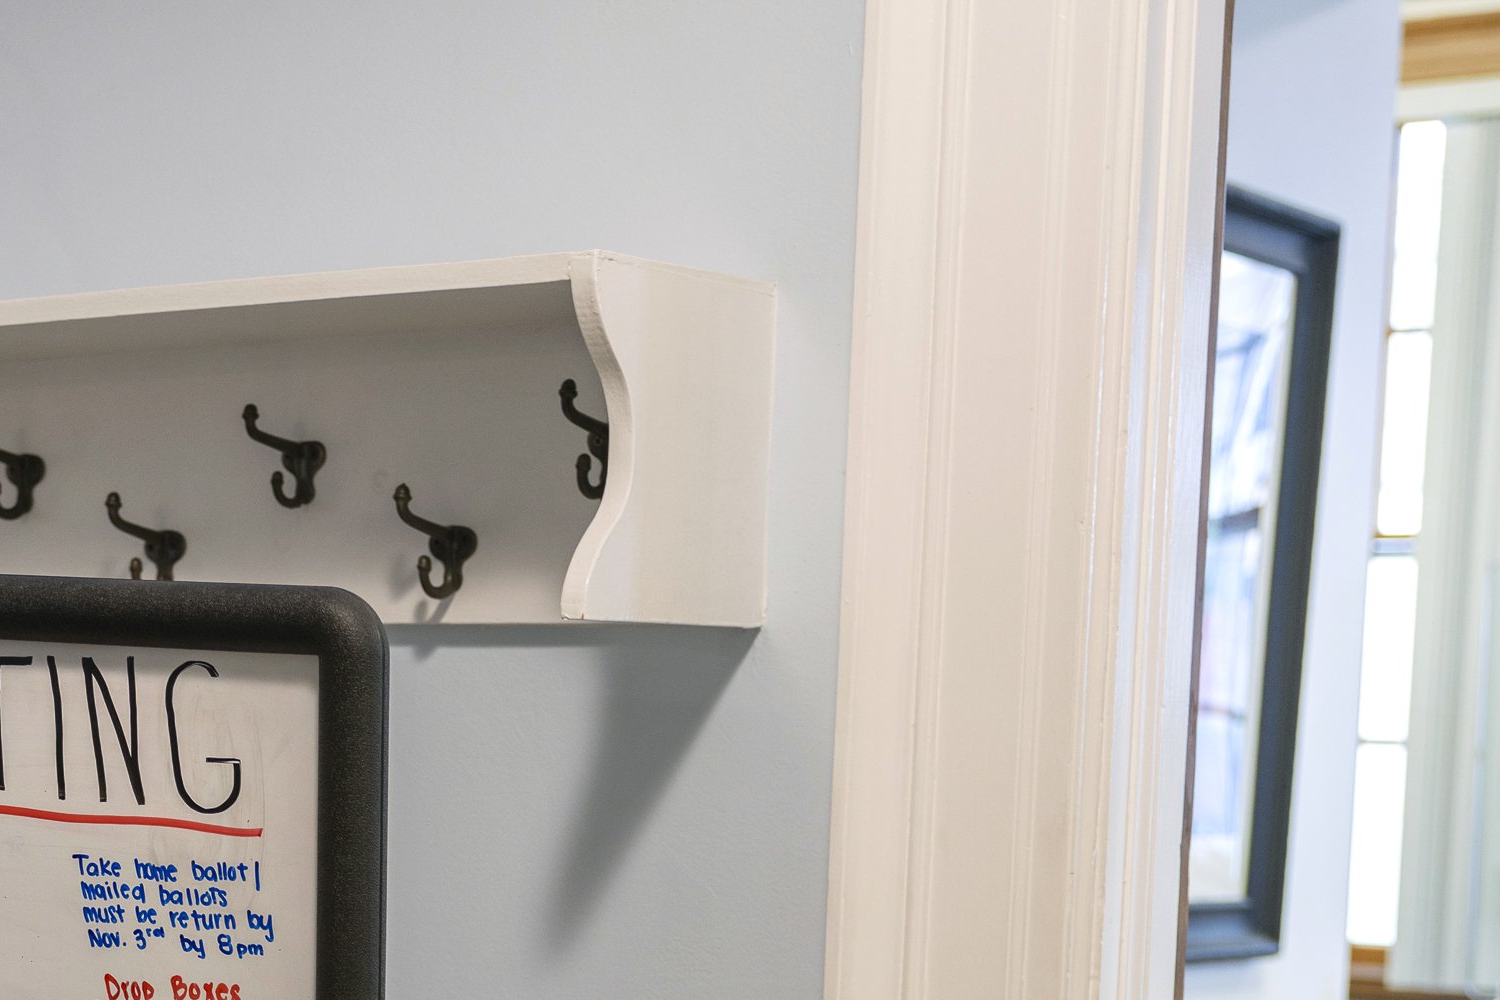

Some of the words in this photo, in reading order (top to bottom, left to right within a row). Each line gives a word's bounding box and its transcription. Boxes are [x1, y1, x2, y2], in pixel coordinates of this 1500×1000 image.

[72, 854, 121, 877] Take
[134, 858, 178, 882] home
[81, 881, 145, 903] mailed
[159, 884, 227, 907] ballots
[83, 904, 125, 923] must
[135, 906, 157, 924] be
[169, 909, 236, 931] return
[247, 910, 274, 943] by
[88, 928, 127, 948] Nov.
[133, 926, 165, 950] 3rd
[180, 934, 206, 959] by
